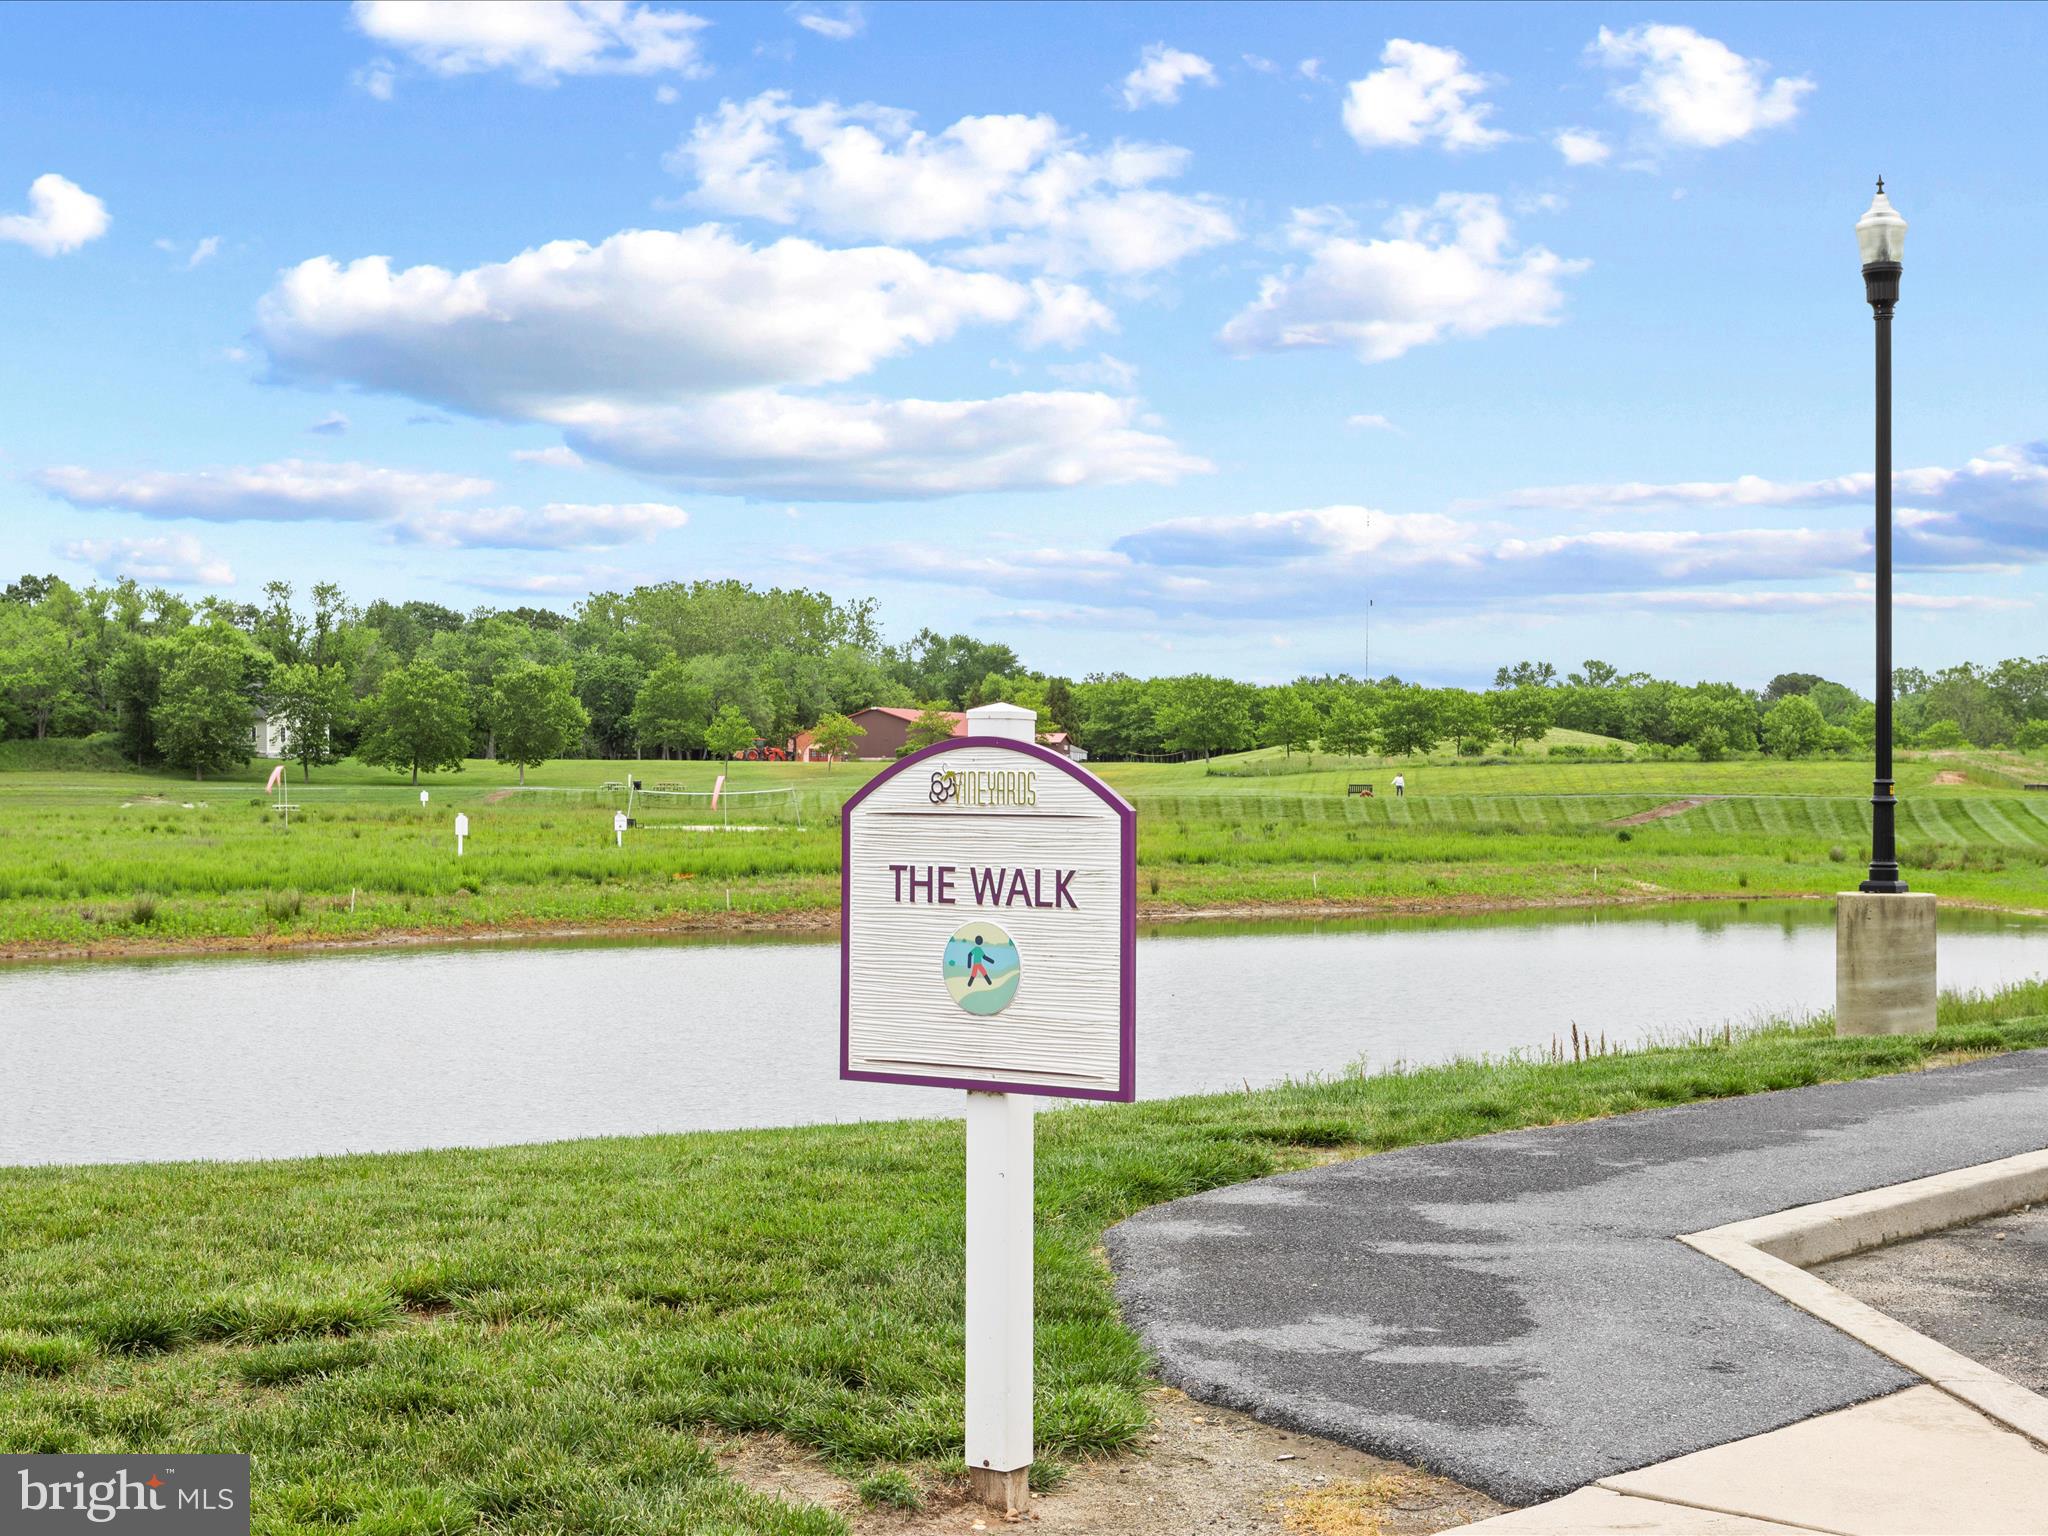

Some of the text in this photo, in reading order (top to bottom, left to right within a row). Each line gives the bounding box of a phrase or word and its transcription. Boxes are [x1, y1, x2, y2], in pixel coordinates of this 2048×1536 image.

[953, 771, 1036, 806] VINEYARDS
[889, 864, 1079, 909] THE WALK
